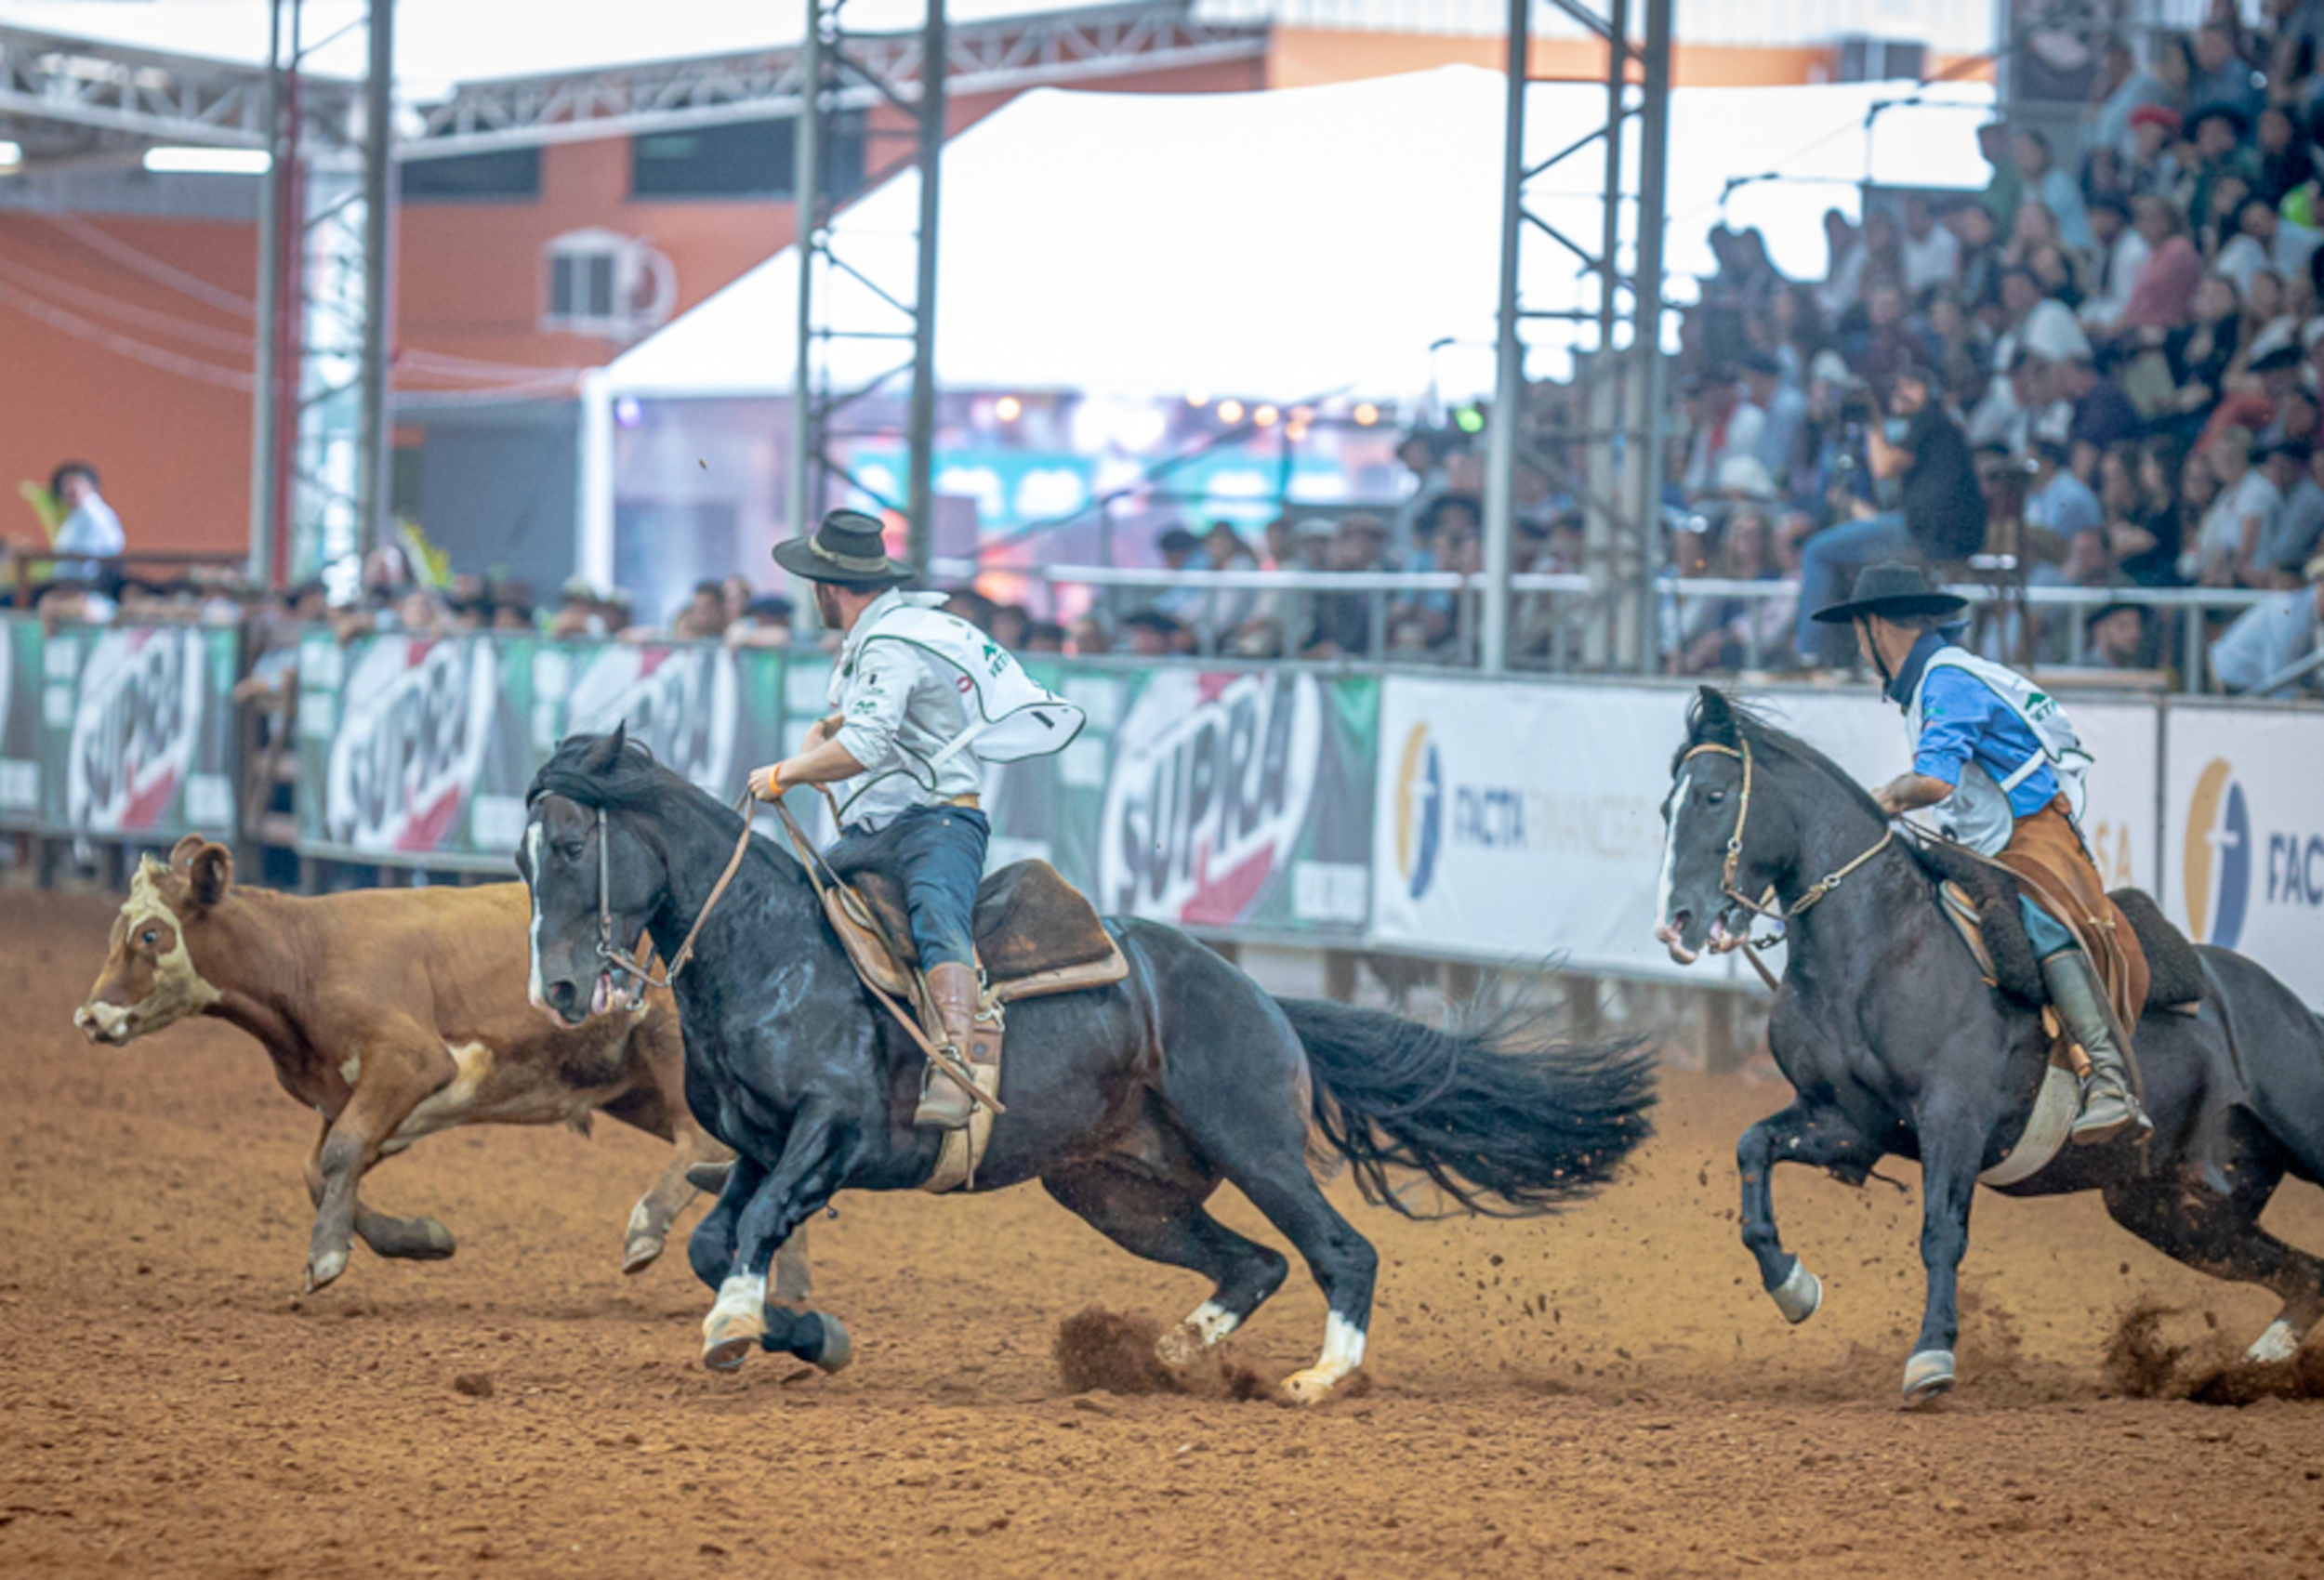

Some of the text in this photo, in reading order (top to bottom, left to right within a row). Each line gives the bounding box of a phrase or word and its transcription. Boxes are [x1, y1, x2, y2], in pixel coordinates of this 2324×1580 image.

[1120, 669, 1298, 903] SUPRA
[1454, 783, 1527, 849] FACTA
[2266, 832, 2324, 906] FAC
